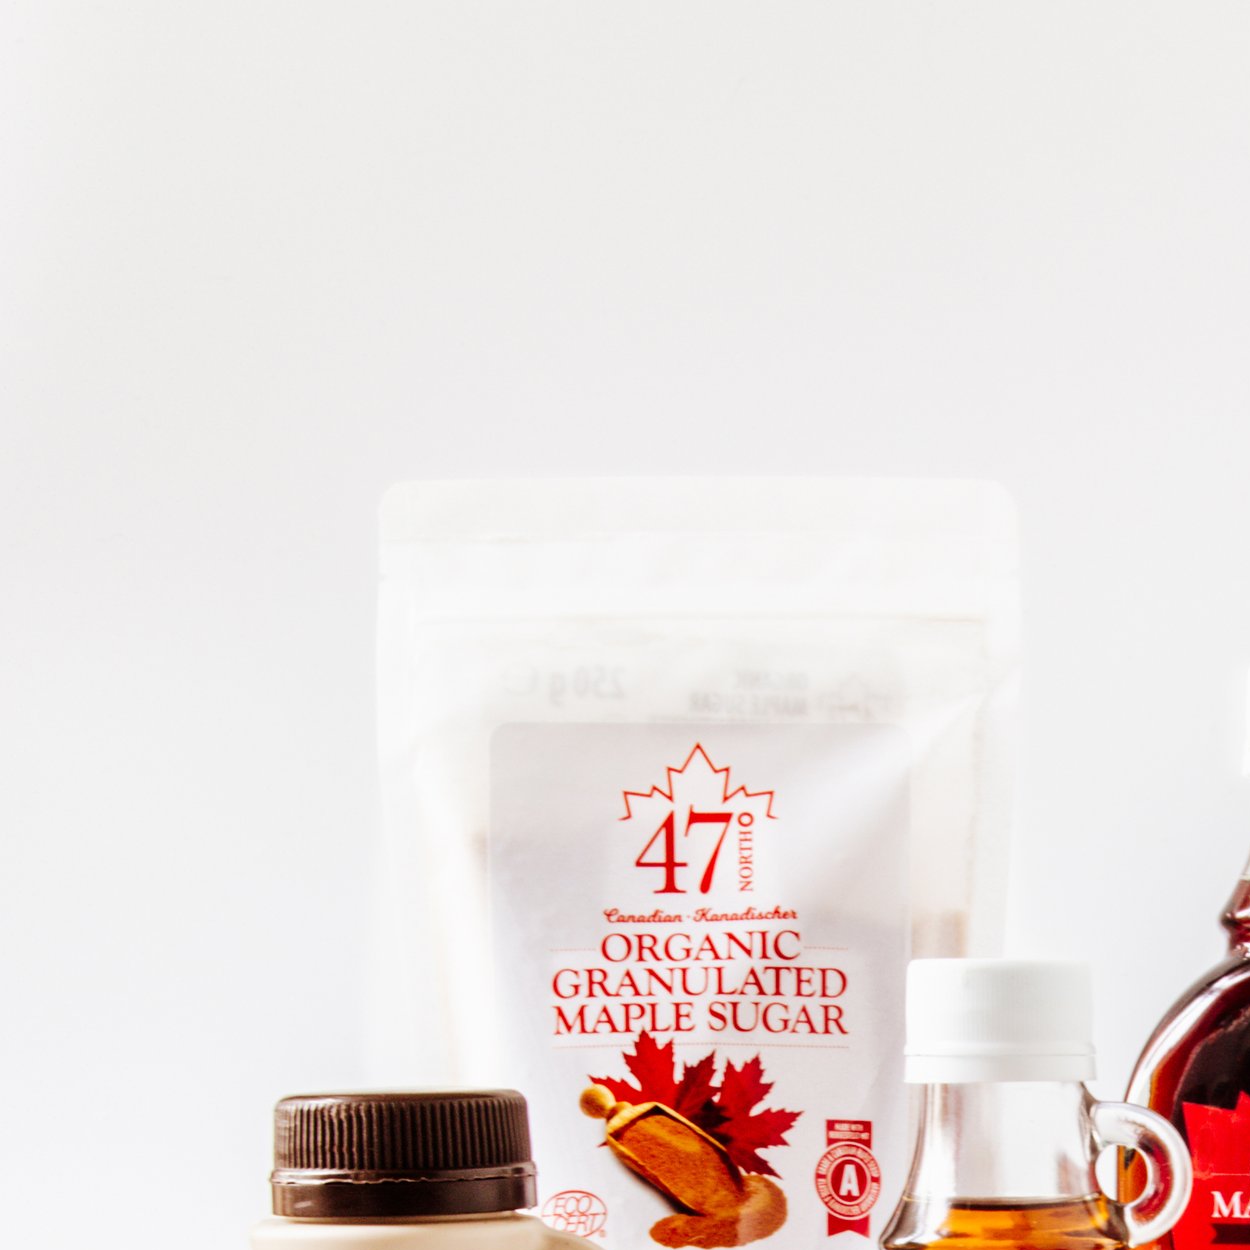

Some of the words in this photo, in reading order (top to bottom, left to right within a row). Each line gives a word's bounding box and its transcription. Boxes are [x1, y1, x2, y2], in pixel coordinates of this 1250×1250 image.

[739, 830, 754, 892] NORTH
[603, 907, 683, 923] Canadian
[692, 905, 798, 922] Kanadischer
[601, 930, 801, 963] ORGANIC
[552, 966, 847, 999] GRANULATED
[553, 1001, 696, 1035] MAPLE
[707, 1001, 850, 1035] SUGAR
[839, 1163, 861, 1197] A
